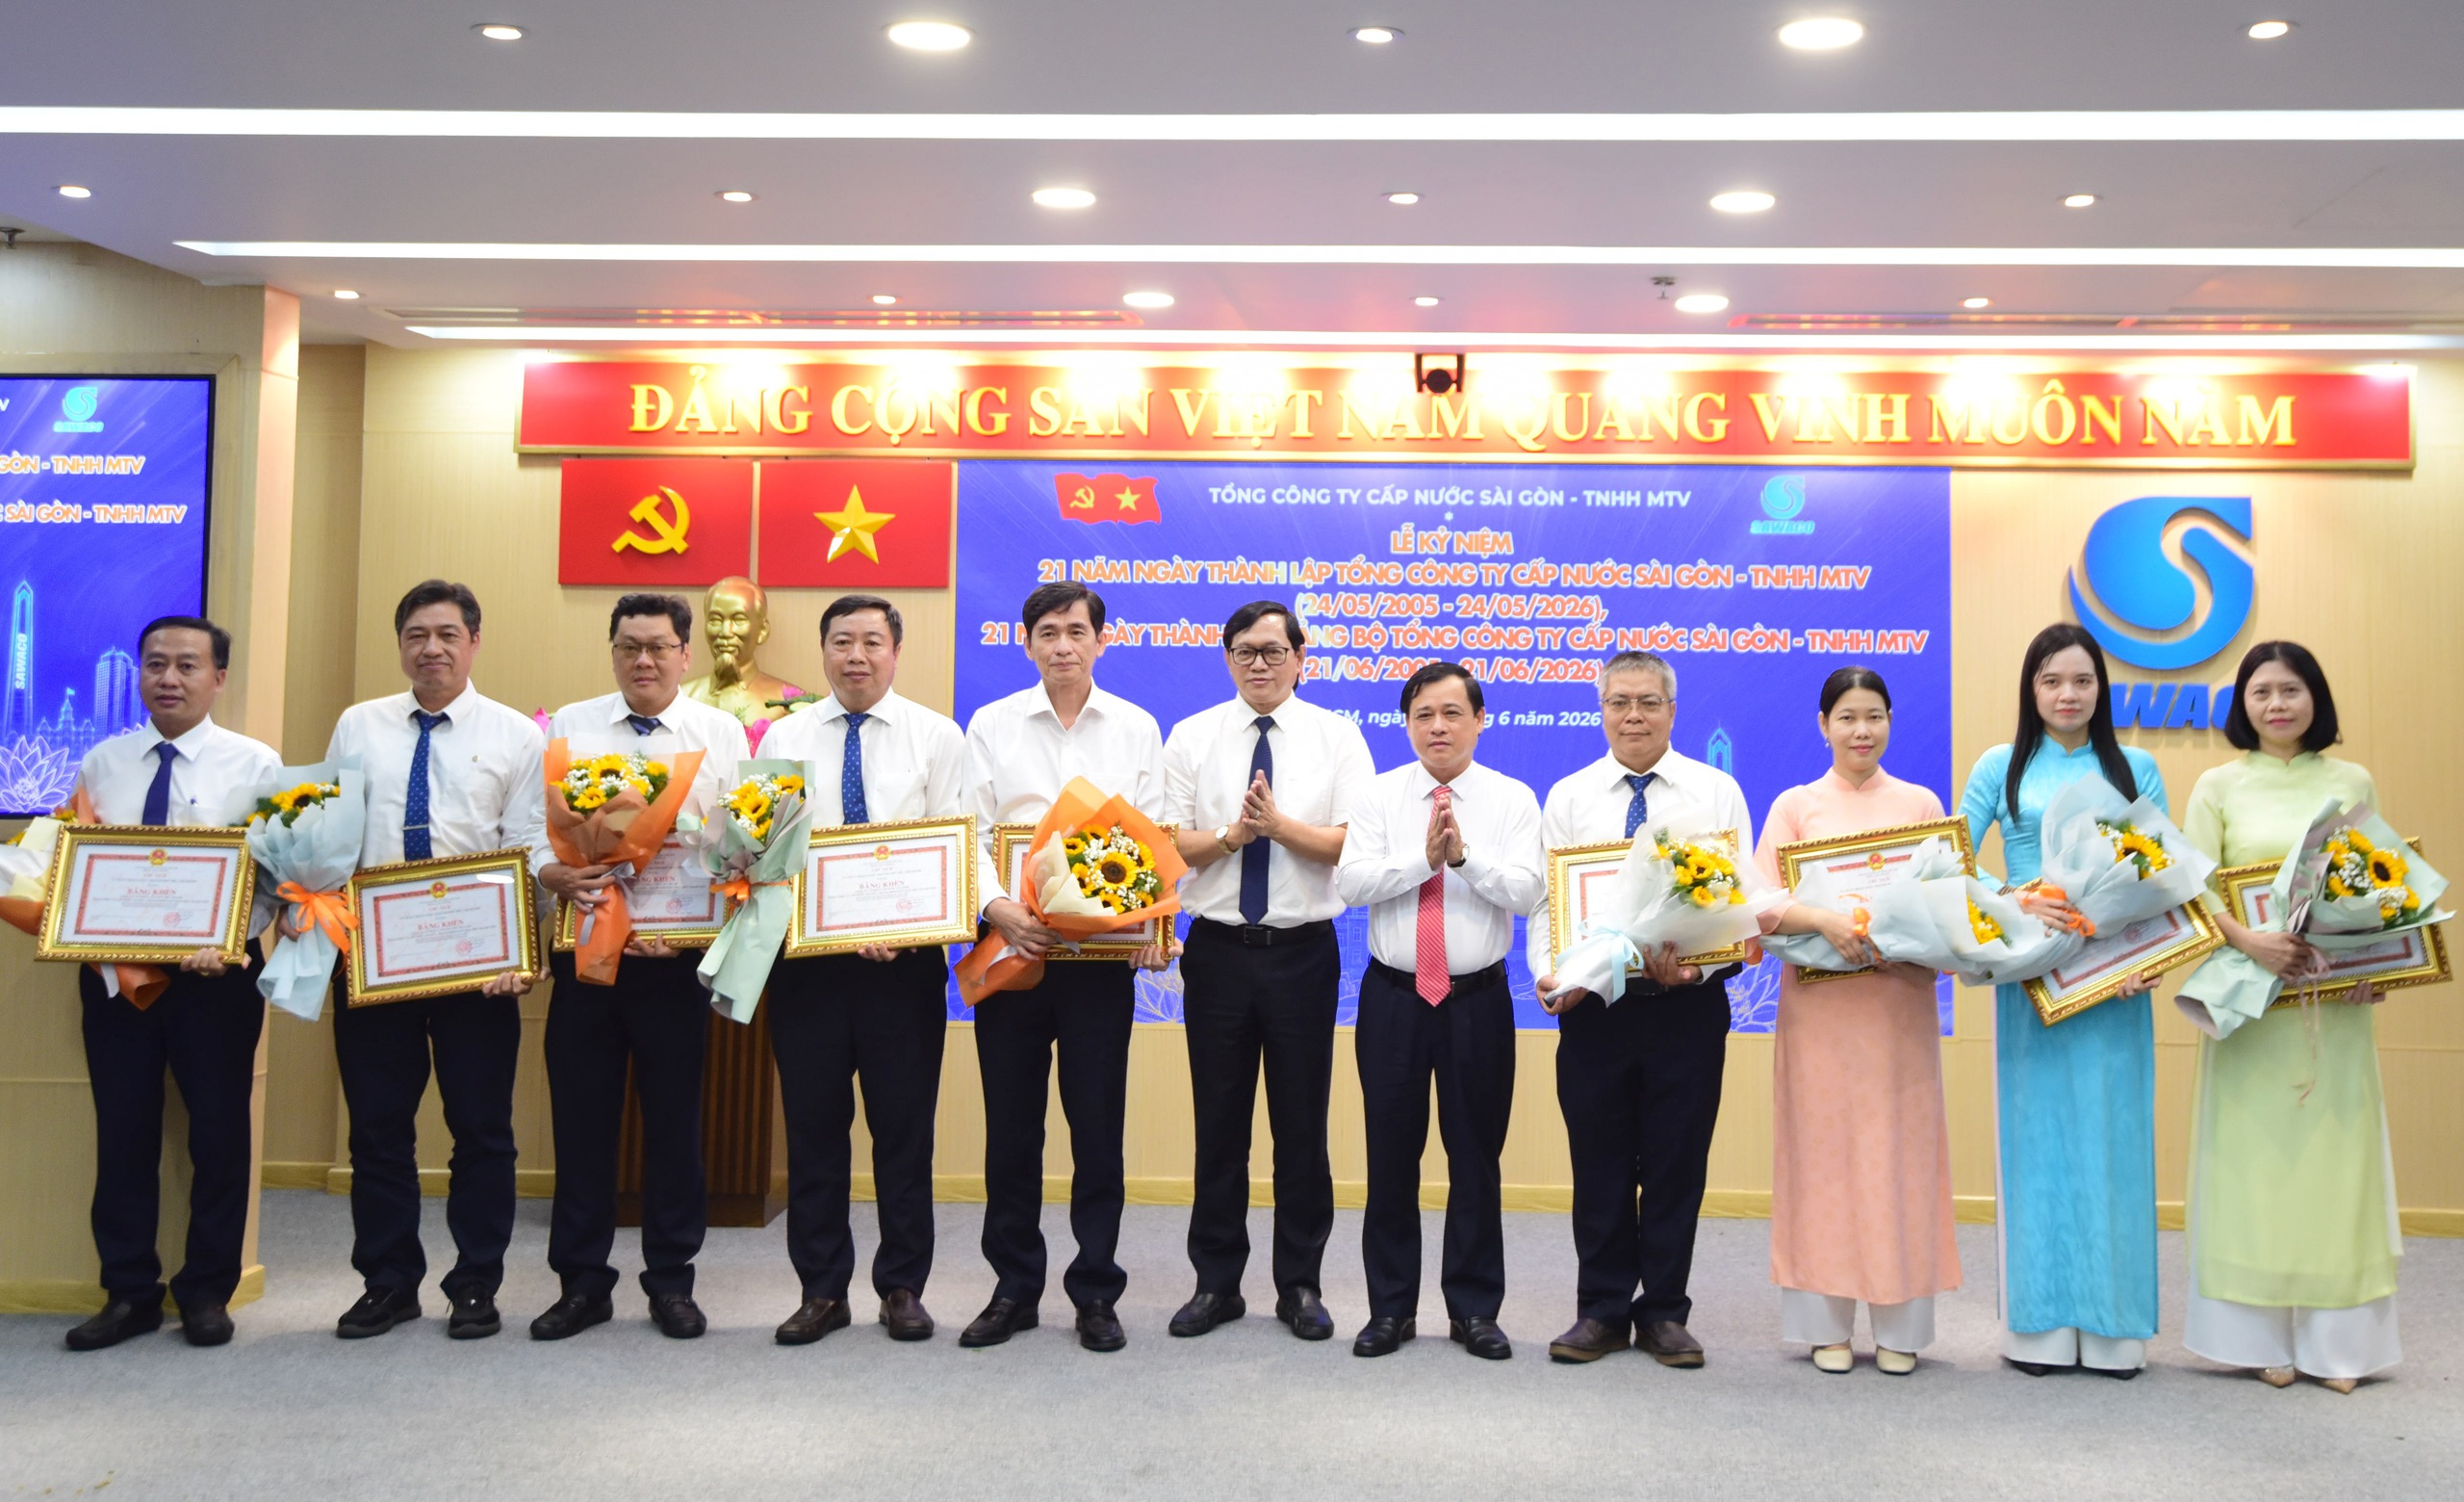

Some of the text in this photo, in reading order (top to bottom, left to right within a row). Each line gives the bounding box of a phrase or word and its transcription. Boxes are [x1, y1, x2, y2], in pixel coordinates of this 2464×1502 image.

[629, 364, 813, 435] ĐẢNG
[1338, 390, 1485, 439] NAM
[1501, 392, 1731, 452] QUANG
[1749, 393, 1912, 443] VINH
[1927, 378, 2124, 445] MUÔN
[0, 450, 39, 474] GÒN
[52, 454, 103, 474] TNHH
[105, 454, 145, 475] MTV
[1209, 482, 1266, 505] TỔNG
[1271, 484, 1330, 505] CÔNG
[1336, 488, 1361, 505] TY
[1367, 484, 1408, 505] CẤP
[1414, 485, 1474, 505] NƯỚC
[1479, 486, 1512, 505] SÀI
[1519, 486, 1564, 505] GÒN
[1582, 490, 1641, 506] TNHH
[1647, 491, 1691, 506] MTV
[5, 499, 34, 523] SÀI
[37, 498, 82, 523] GÒN
[93, 503, 145, 523] TNHH
[146, 505, 188, 523] MTV
[1392, 523, 1514, 558] LỄ KỶ NIỆM
[1038, 558, 1066, 583] 21
[1072, 556, 1131, 583] NĂM
[1134, 556, 1203, 583] NGÀY
[1206, 555, 1287, 583] THÀNH
[1290, 558, 1332, 587] LẬP
[1336, 554, 1401, 584] TỔNG
[1406, 558, 1476, 584] CÔNG
[1480, 563, 1509, 585] TY
[1512, 557, 1558, 586] CẤP
[1561, 558, 1630, 586] NƯỚC
[1634, 558, 1672, 586] SÀI
[1675, 558, 1733, 588] GÒN
[1750, 565, 1816, 589] TNHH
[1819, 565, 1872, 590] MTV
[1295, 593, 1439, 619] (24/05/2005
[1455, 594, 1608, 622] 24/05/2026),
[981, 621, 1010, 645] 21
[1103, 617, 1146, 646] GÀY
[1351, 621, 1388, 652] BỘ
[1391, 619, 1458, 649] TỔNG
[1462, 622, 1534, 650] CÔNG
[1536, 627, 1567, 650] TY
[1568, 622, 1613, 651] CẤP
[1617, 622, 1688, 651] NƯỚC
[1690, 622, 1728, 651] SÀI
[1732, 622, 1790, 652] GÒN
[1808, 630, 1873, 653] TNHH
[1876, 631, 1929, 654] MTV
[1499, 711, 1510, 725] 6
[1514, 711, 1553, 725] năm
[1557, 712, 1602, 726] 2026
